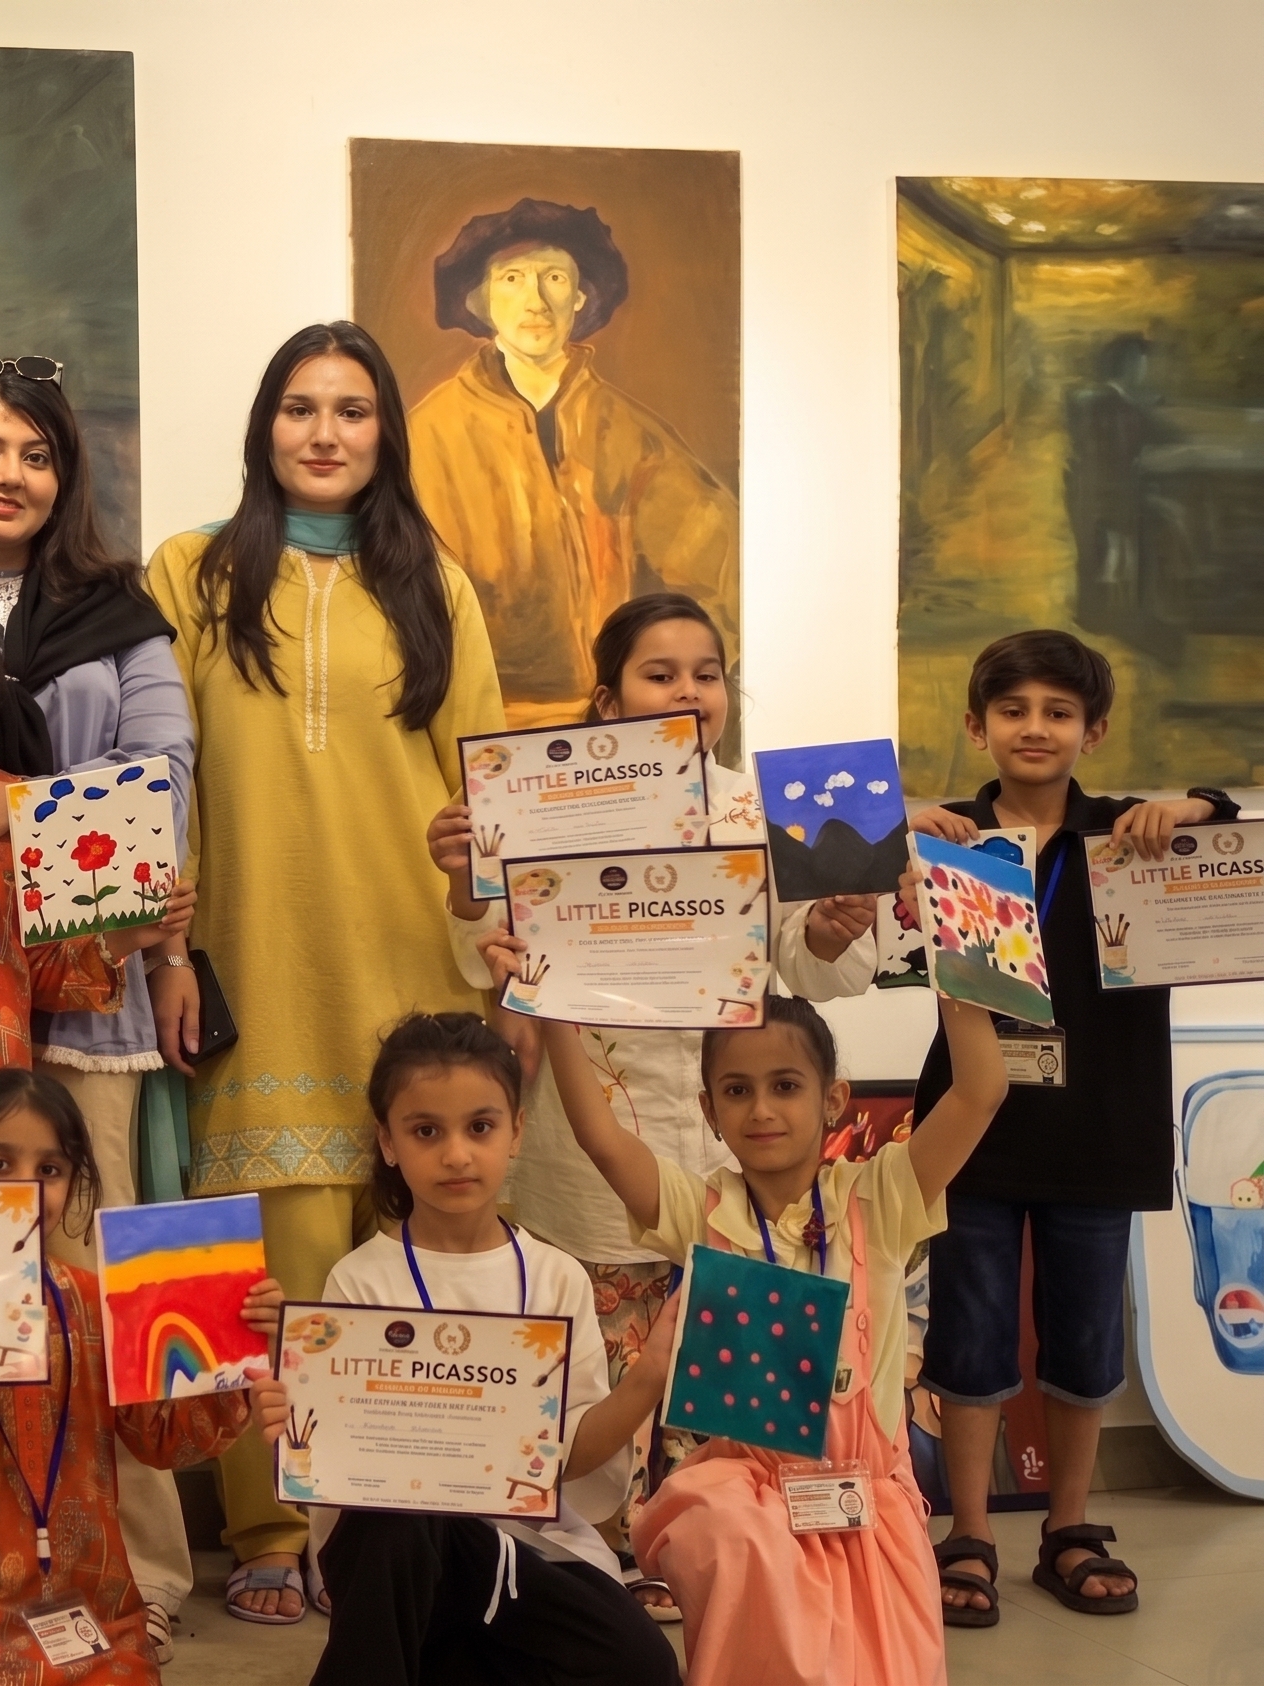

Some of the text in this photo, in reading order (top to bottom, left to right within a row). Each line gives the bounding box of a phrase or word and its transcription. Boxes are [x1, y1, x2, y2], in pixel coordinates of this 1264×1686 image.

[507, 772, 568, 794] LITTLE
[574, 762, 663, 785] PICASSOS
[1130, 865, 1192, 885] LITTLE
[556, 899, 725, 922] LITTLE PICASSOS
[330, 1356, 518, 1385] LITTLE PICASSOS
